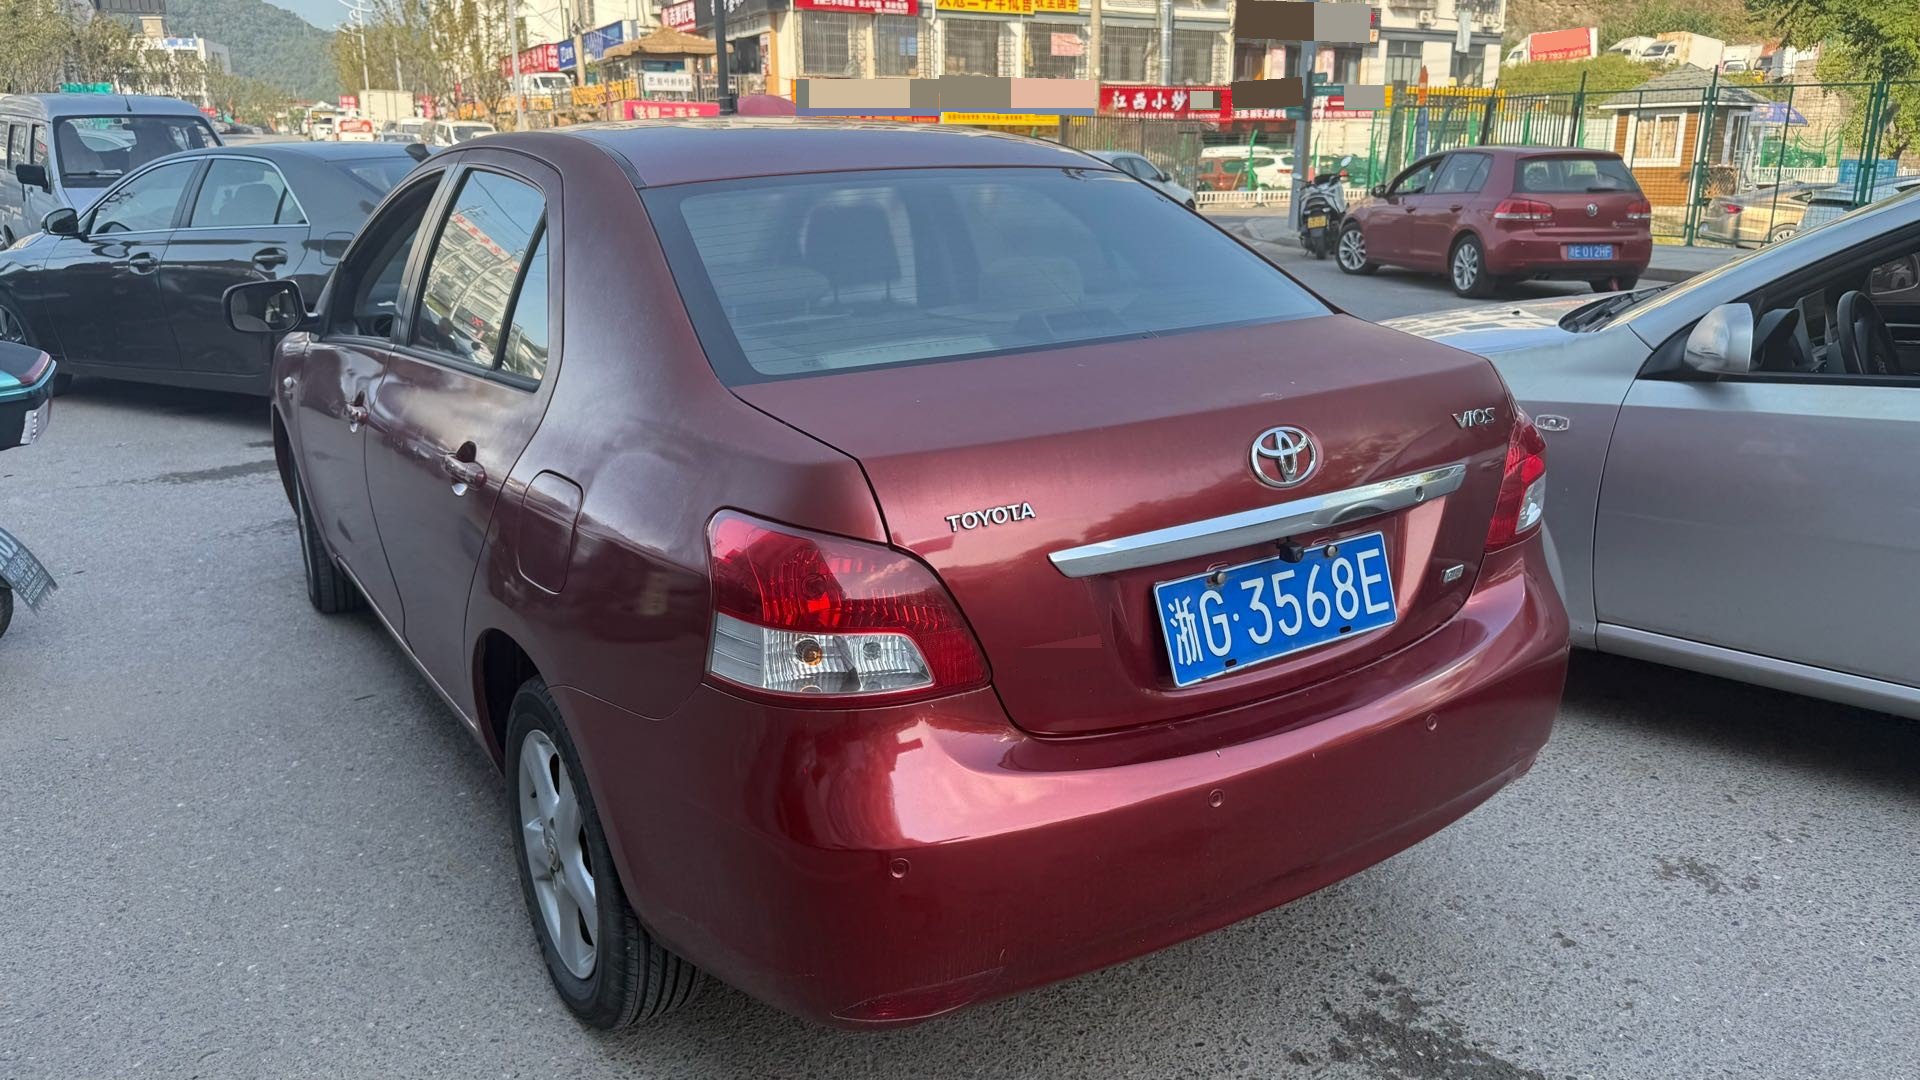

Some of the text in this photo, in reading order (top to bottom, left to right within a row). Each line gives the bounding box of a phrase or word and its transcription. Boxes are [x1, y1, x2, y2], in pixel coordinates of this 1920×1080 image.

[1112, 90, 1188, 111] 江西小炒
[1451, 406, 1496, 429] VIOS
[944, 501, 1036, 532] TOYOTA
